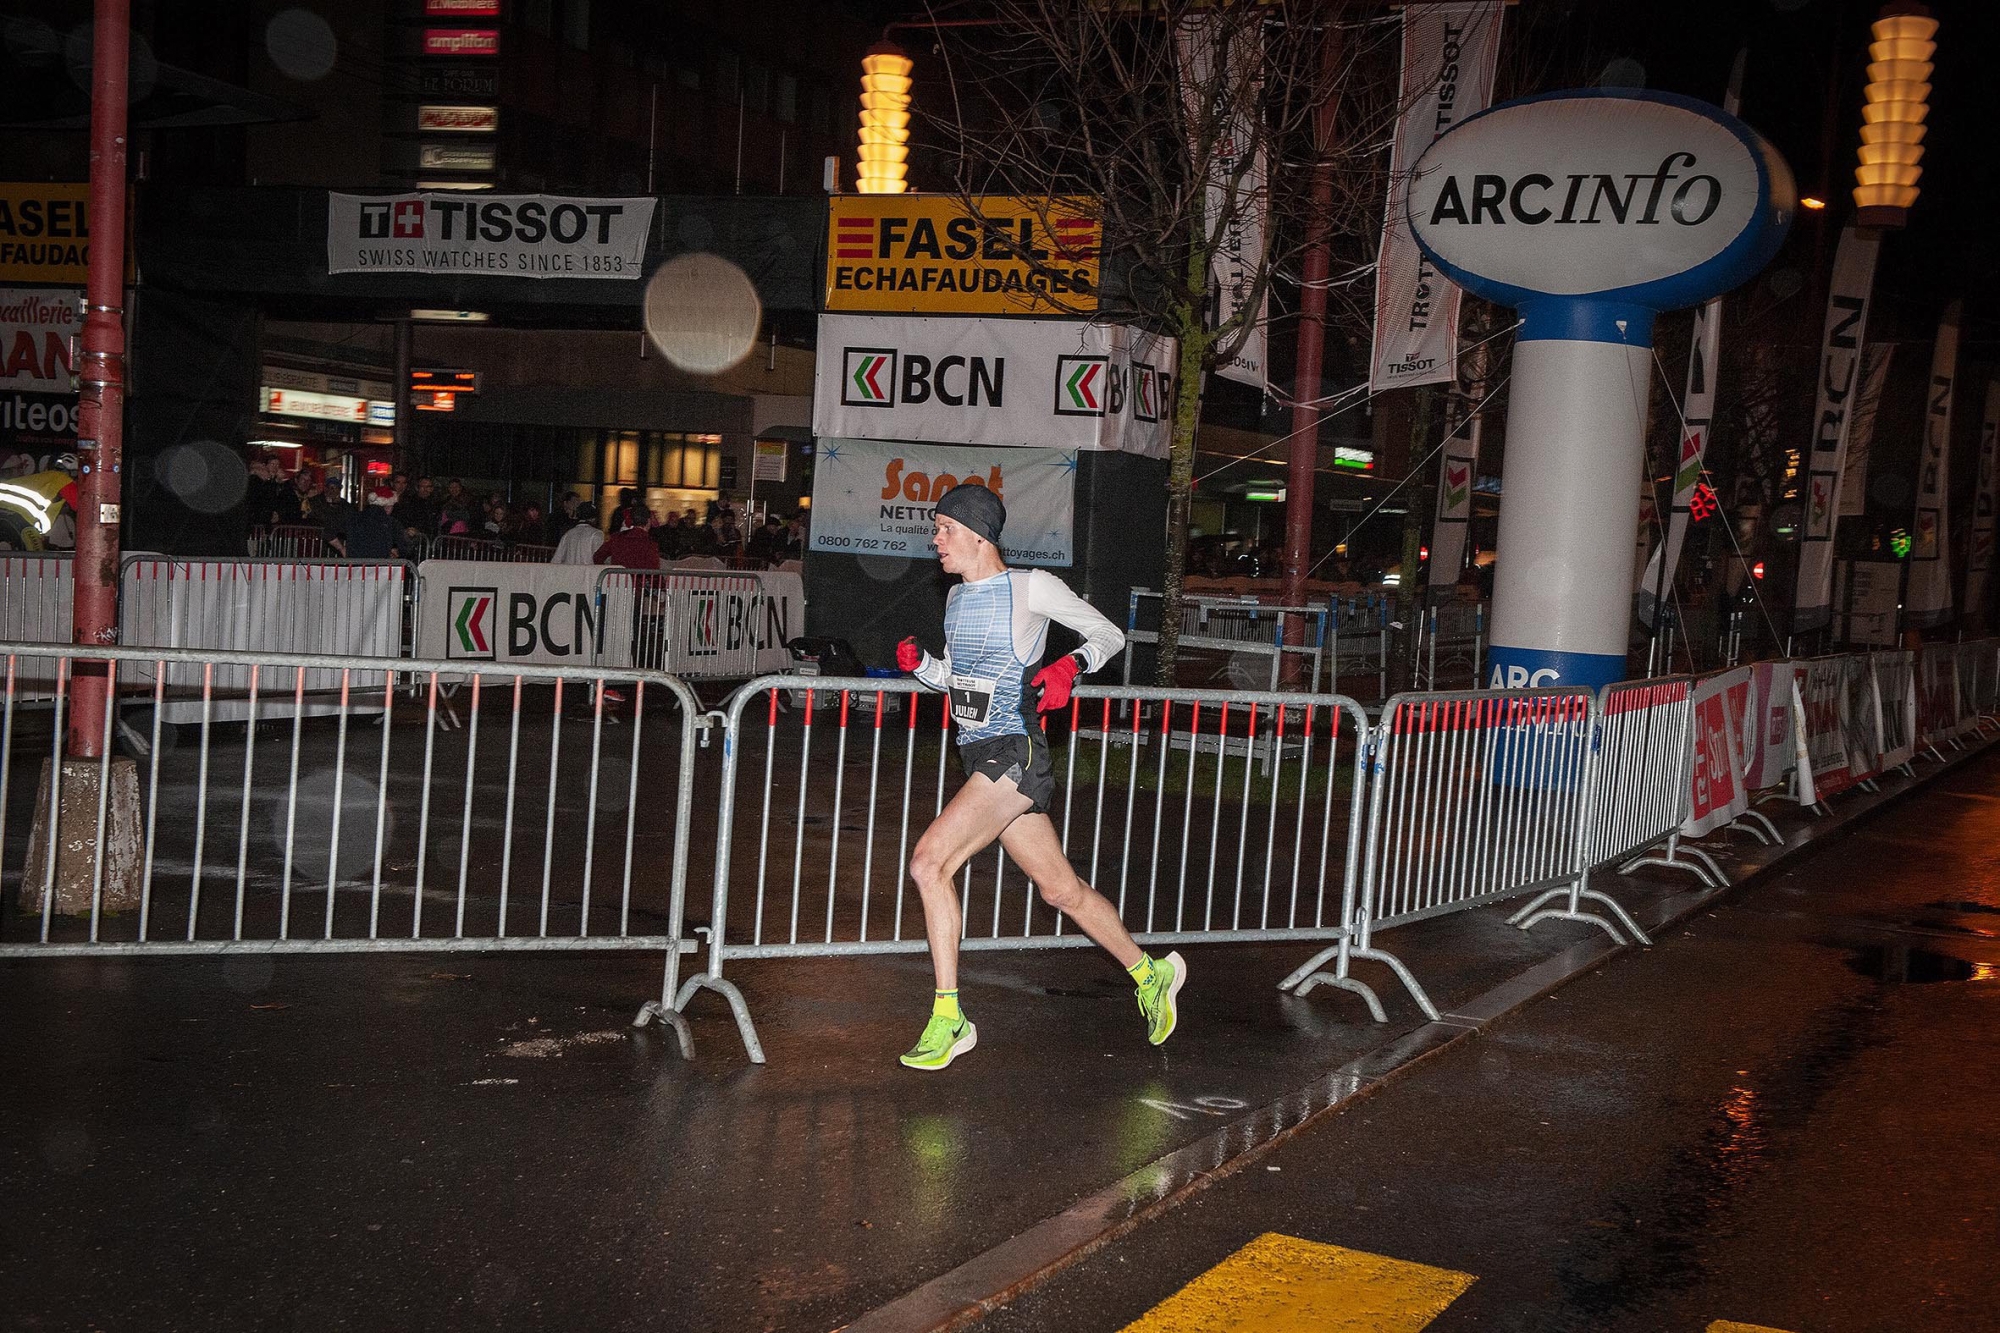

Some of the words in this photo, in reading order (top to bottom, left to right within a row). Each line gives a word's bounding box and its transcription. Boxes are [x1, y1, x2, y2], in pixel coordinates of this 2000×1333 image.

[1435, 21, 1462, 131] TISSOT
[0, 199, 89, 238] ASEL
[430, 202, 623, 244] TISSOT
[878, 217, 1049, 261] FASEL
[359, 250, 414, 266] SWISS
[424, 251, 508, 269] WATCHES
[518, 253, 573, 272] SINCE
[582, 255, 623, 272] 1853
[834, 266, 1093, 294] ECHAFAUDAGES
[0, 297, 73, 324] caillerie
[0, 330, 74, 380] AN
[1388, 358, 1435, 374] TISSOT
[1816, 295, 1866, 452] BCN
[901, 354, 1005, 408] BCN
[0, 395, 79, 433] iteos
[818, 535, 851, 547] 0800
[854, 538, 879, 549] 762
[882, 540, 907, 551] 762
[880, 523, 893, 533] La
[895, 525, 929, 536] qualité
[508, 592, 607, 657] BCN
[726, 595, 788, 651] BCN
[955, 704, 979, 720] JULIEN
[964, 691, 970, 704] 1
